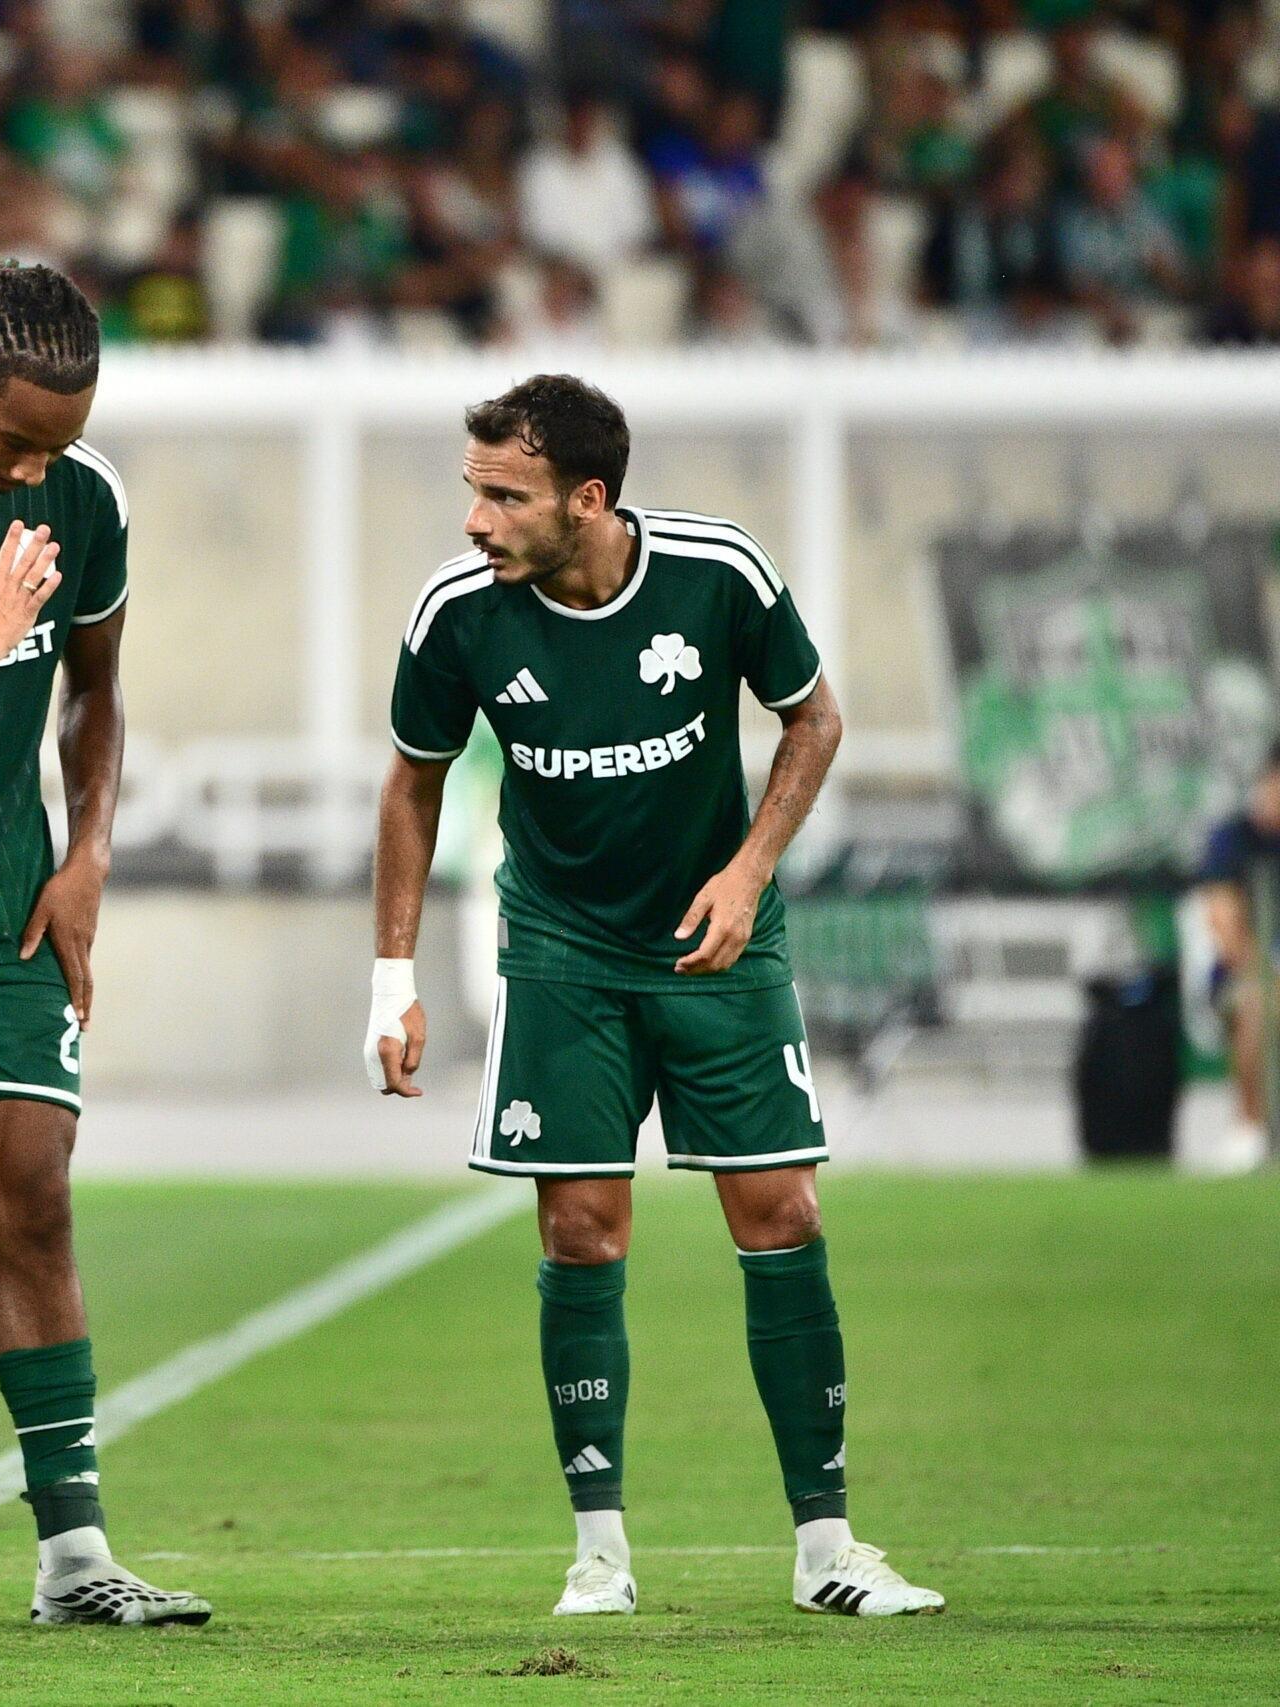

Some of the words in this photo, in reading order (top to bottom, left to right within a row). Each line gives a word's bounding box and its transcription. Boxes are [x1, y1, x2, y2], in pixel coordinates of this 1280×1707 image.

[510, 711, 706, 780] SUPERBET
[782, 1040, 821, 1123] 4
[554, 1378, 610, 1406] 1908
